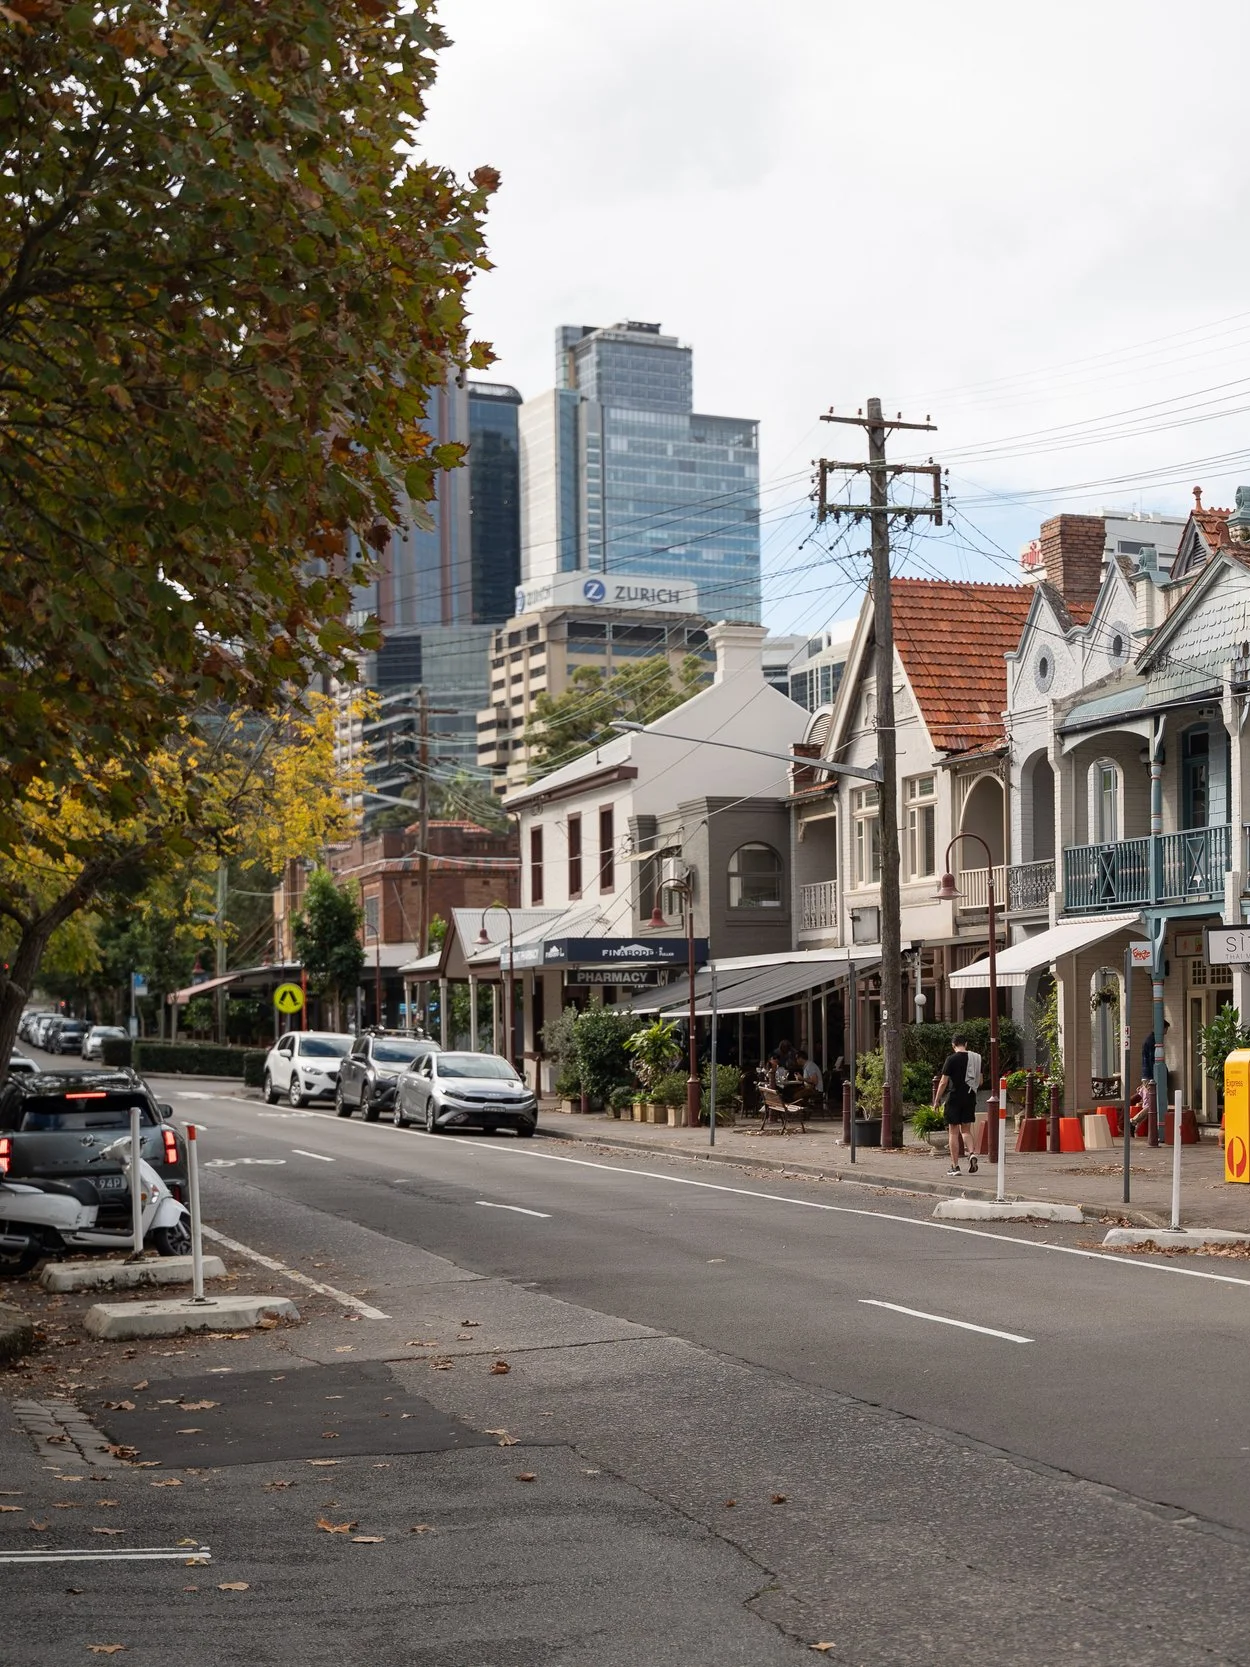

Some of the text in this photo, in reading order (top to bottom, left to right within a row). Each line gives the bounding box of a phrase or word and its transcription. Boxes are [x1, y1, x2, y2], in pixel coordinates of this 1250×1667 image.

[615, 586, 680, 603] ZURICH
[577, 973, 648, 982] PHARMACY
[1226, 1079, 1243, 1088] Express
[1226, 1088, 1237, 1096] Post
